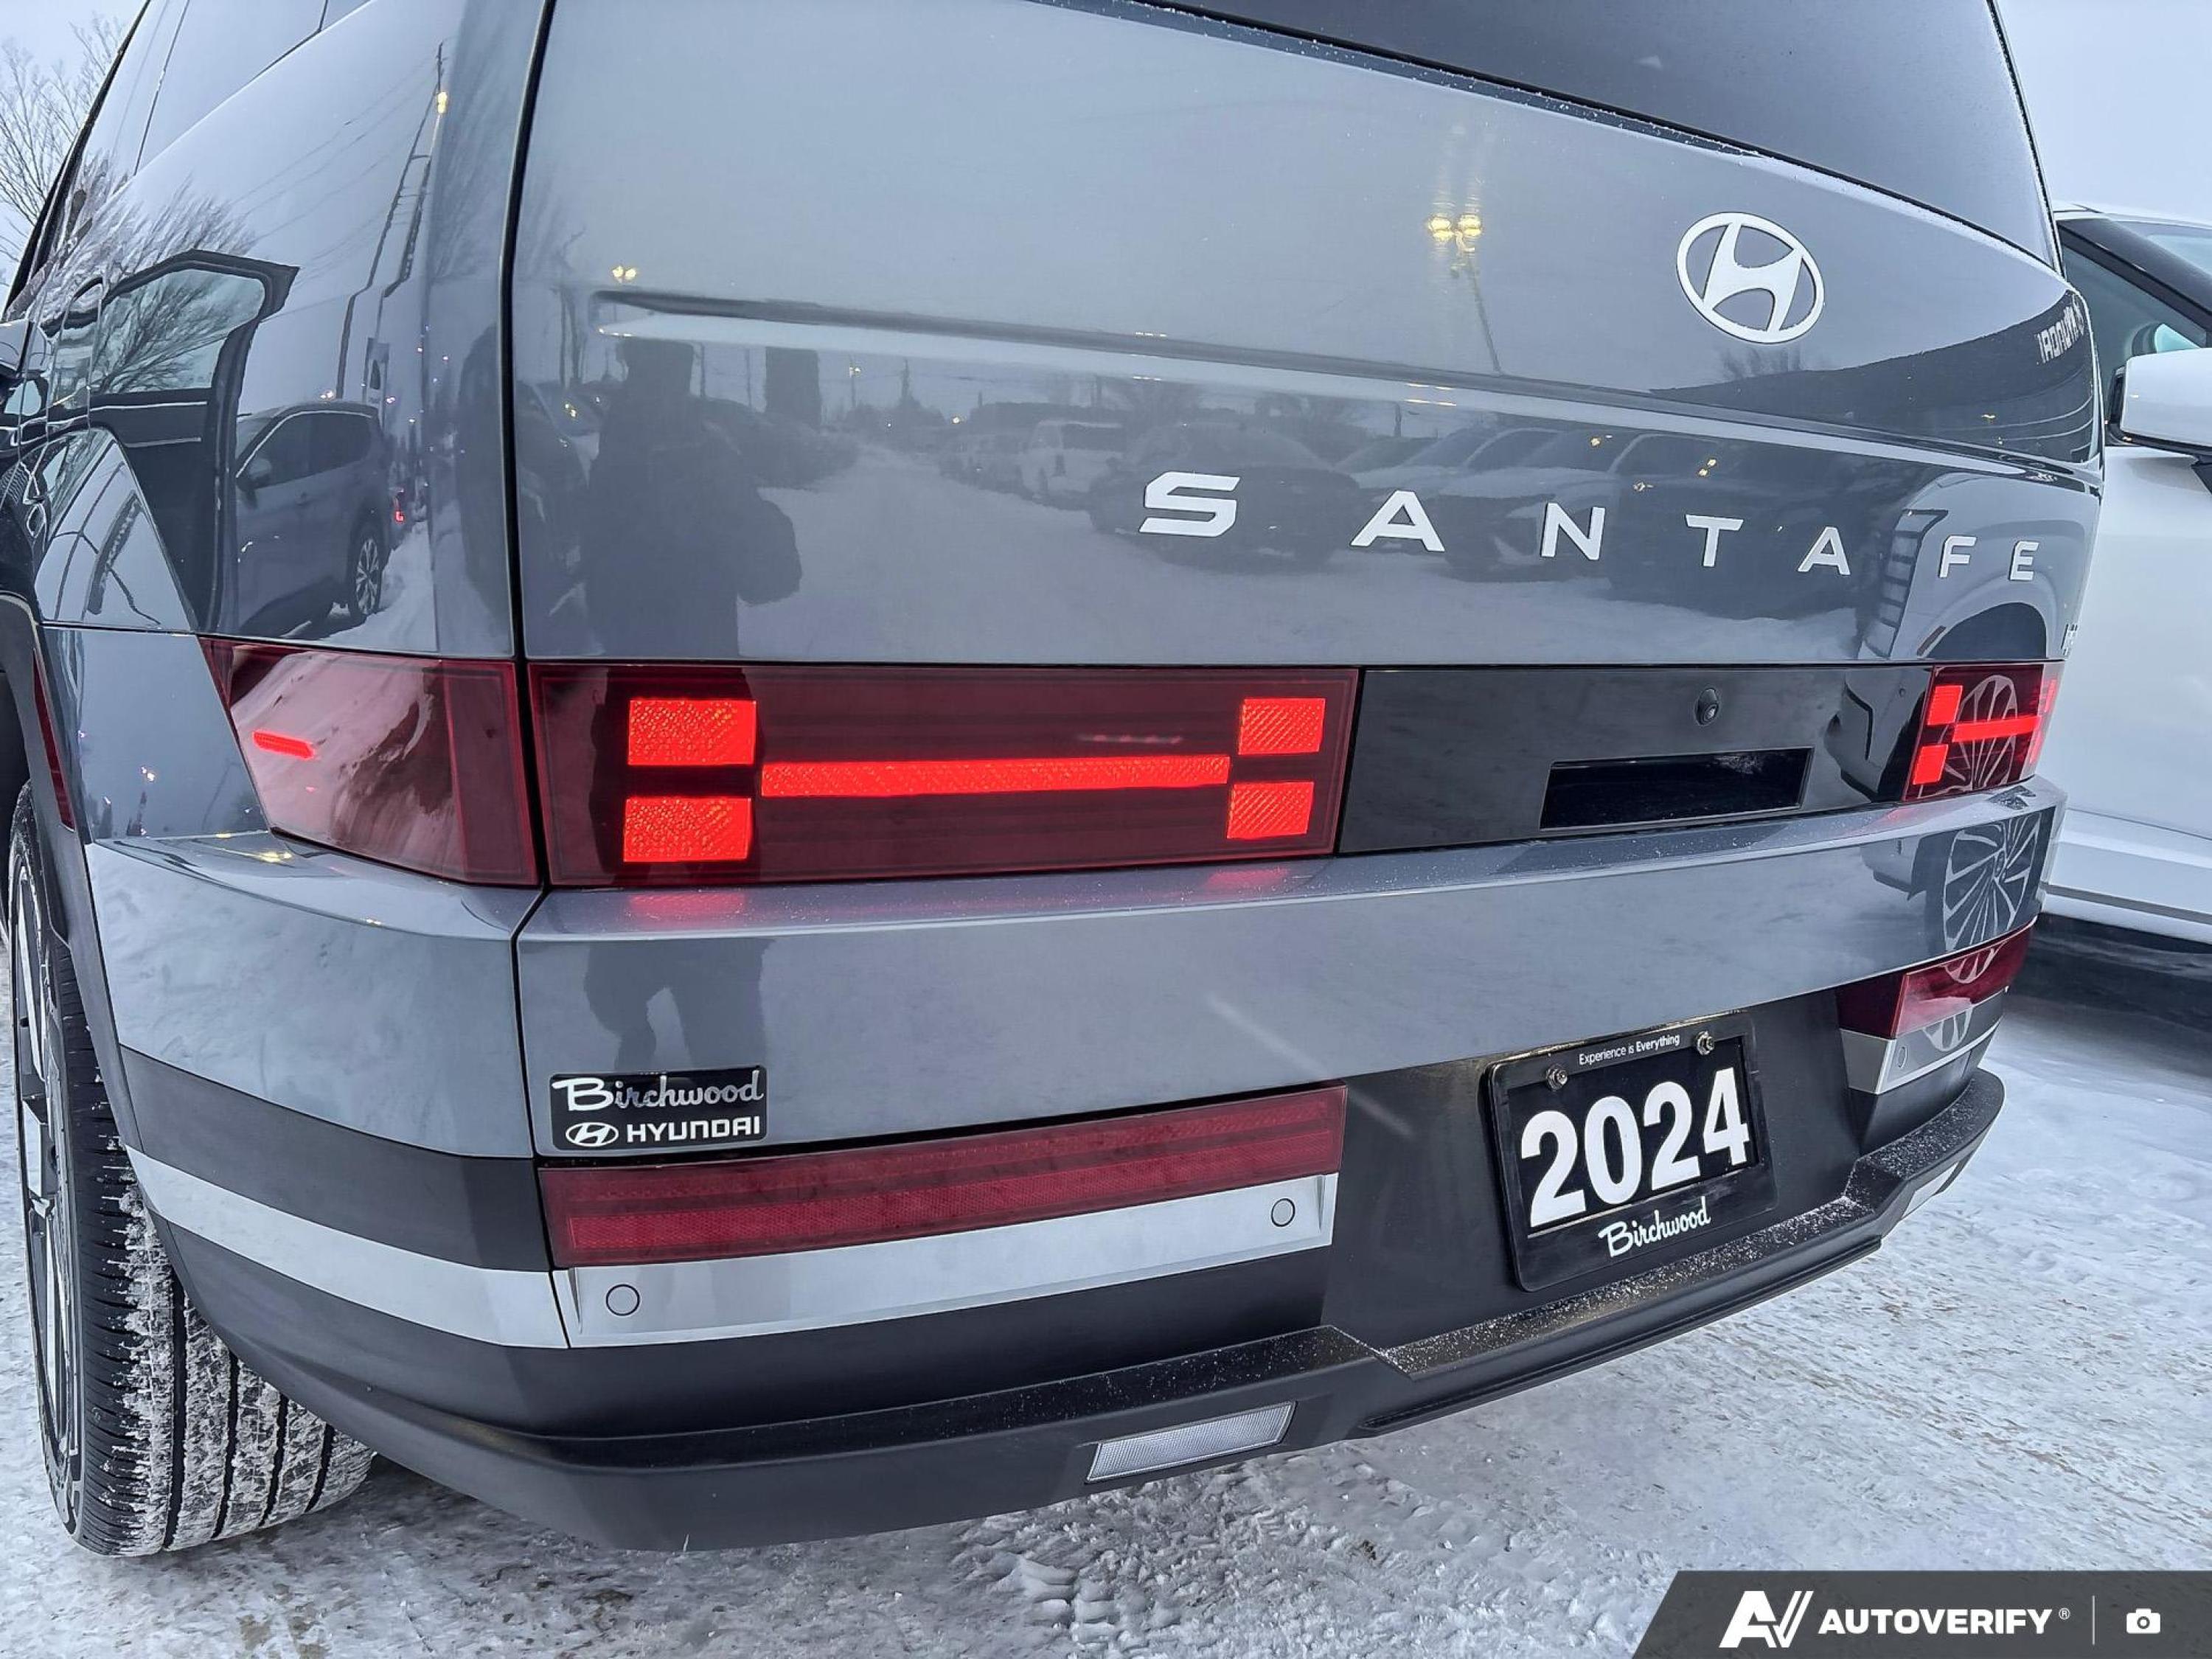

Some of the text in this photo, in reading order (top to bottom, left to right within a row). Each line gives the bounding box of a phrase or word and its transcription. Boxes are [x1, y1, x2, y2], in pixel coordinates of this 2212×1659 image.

[1139, 471, 2041, 582] SANTA FE
[1579, 1034, 1680, 1065] Experience is Everything
[552, 1070, 765, 1111] Birchwood
[627, 1116, 760, 1142] HYUNDAI
[1521, 1067, 1750, 1228] 2024
[1598, 1196, 1711, 1258] Birchwood
